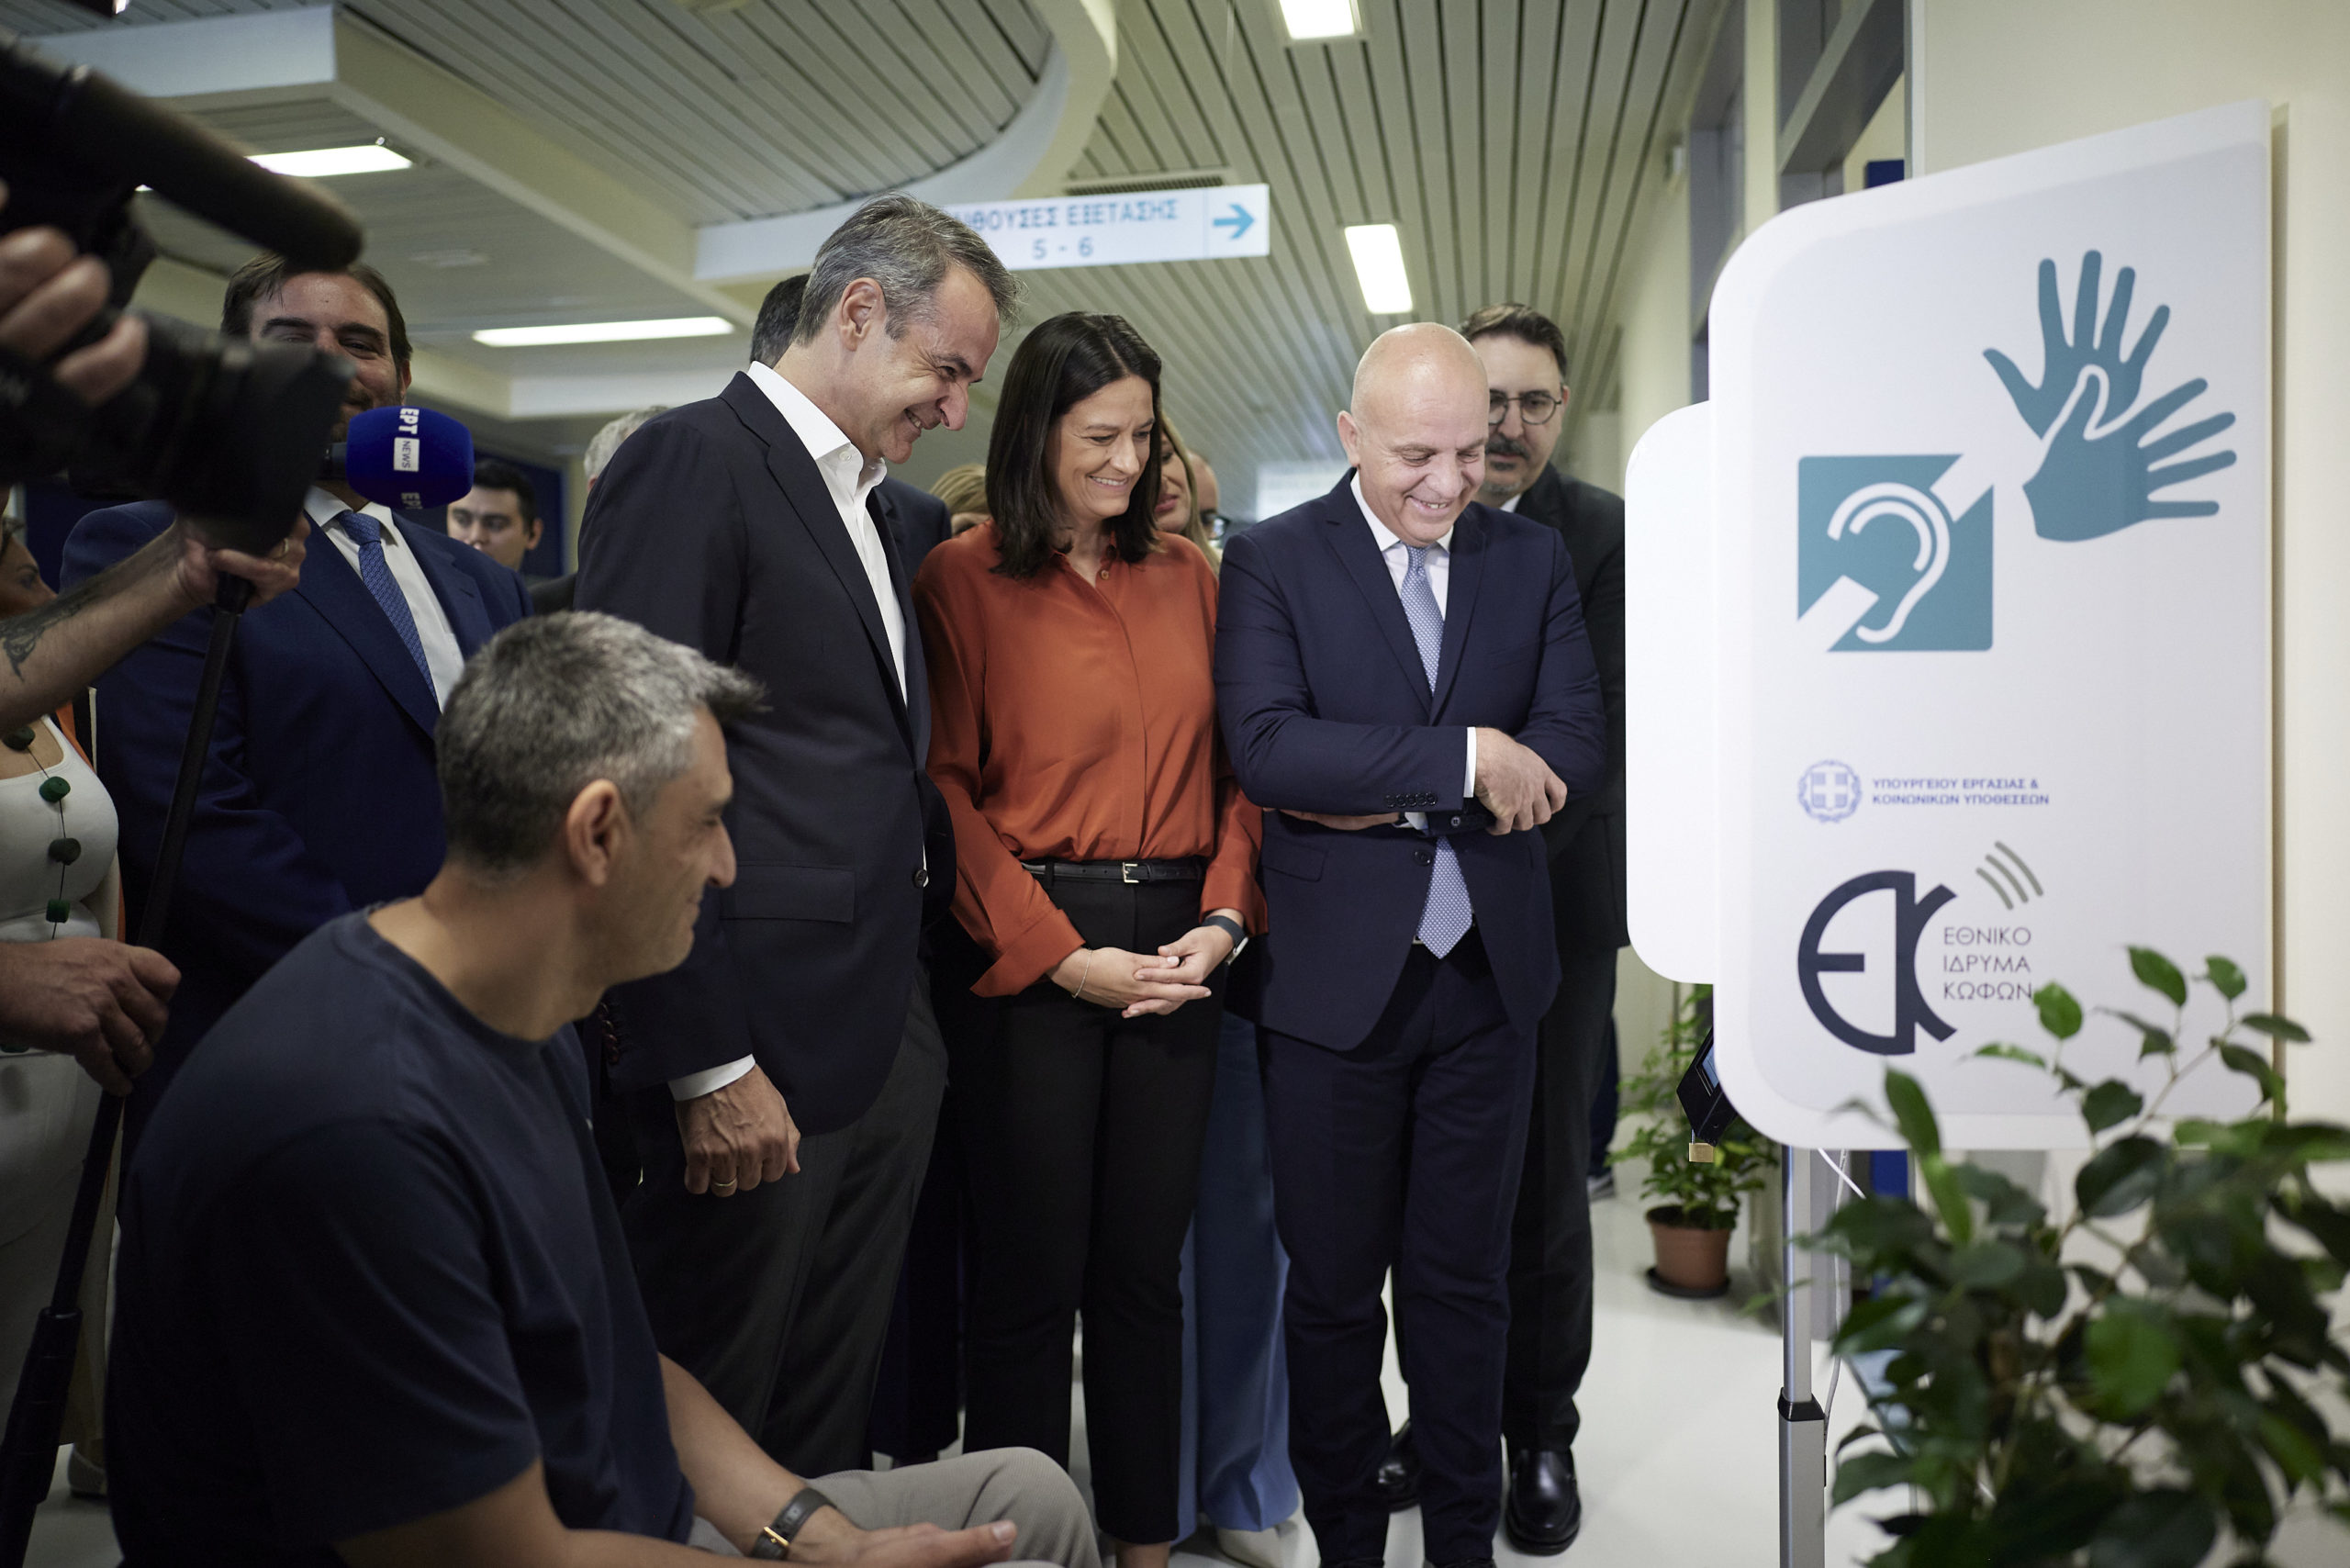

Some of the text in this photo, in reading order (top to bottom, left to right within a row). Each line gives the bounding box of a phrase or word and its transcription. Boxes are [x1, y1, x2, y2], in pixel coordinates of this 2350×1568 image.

[955, 198, 1178, 231] ΙΘΟΥΣΕΣ ΕΞΕΤΑΣΗΣ
[1033, 238, 1046, 260] 5
[1078, 236, 1093, 257] 6
[398, 408, 420, 434] ΕΡΤ
[401, 440, 411, 468] NEWS
[1872, 778, 2039, 790] ΥΠΟΥΡΓΕΙΟΥ ΕΡΓΑΣΙΑΣ &
[1872, 794, 2050, 805] ΚΟΙΝΩΝΙΚΩΝ ΥΠΟΘΕΣΕΩΝ
[1943, 926, 2031, 946] ΕΘΝΙΚΟ
[1943, 955, 2031, 973] ΙΔΡΥΜΑ
[1943, 981, 2032, 1001] ΚΩΦΩΝ
